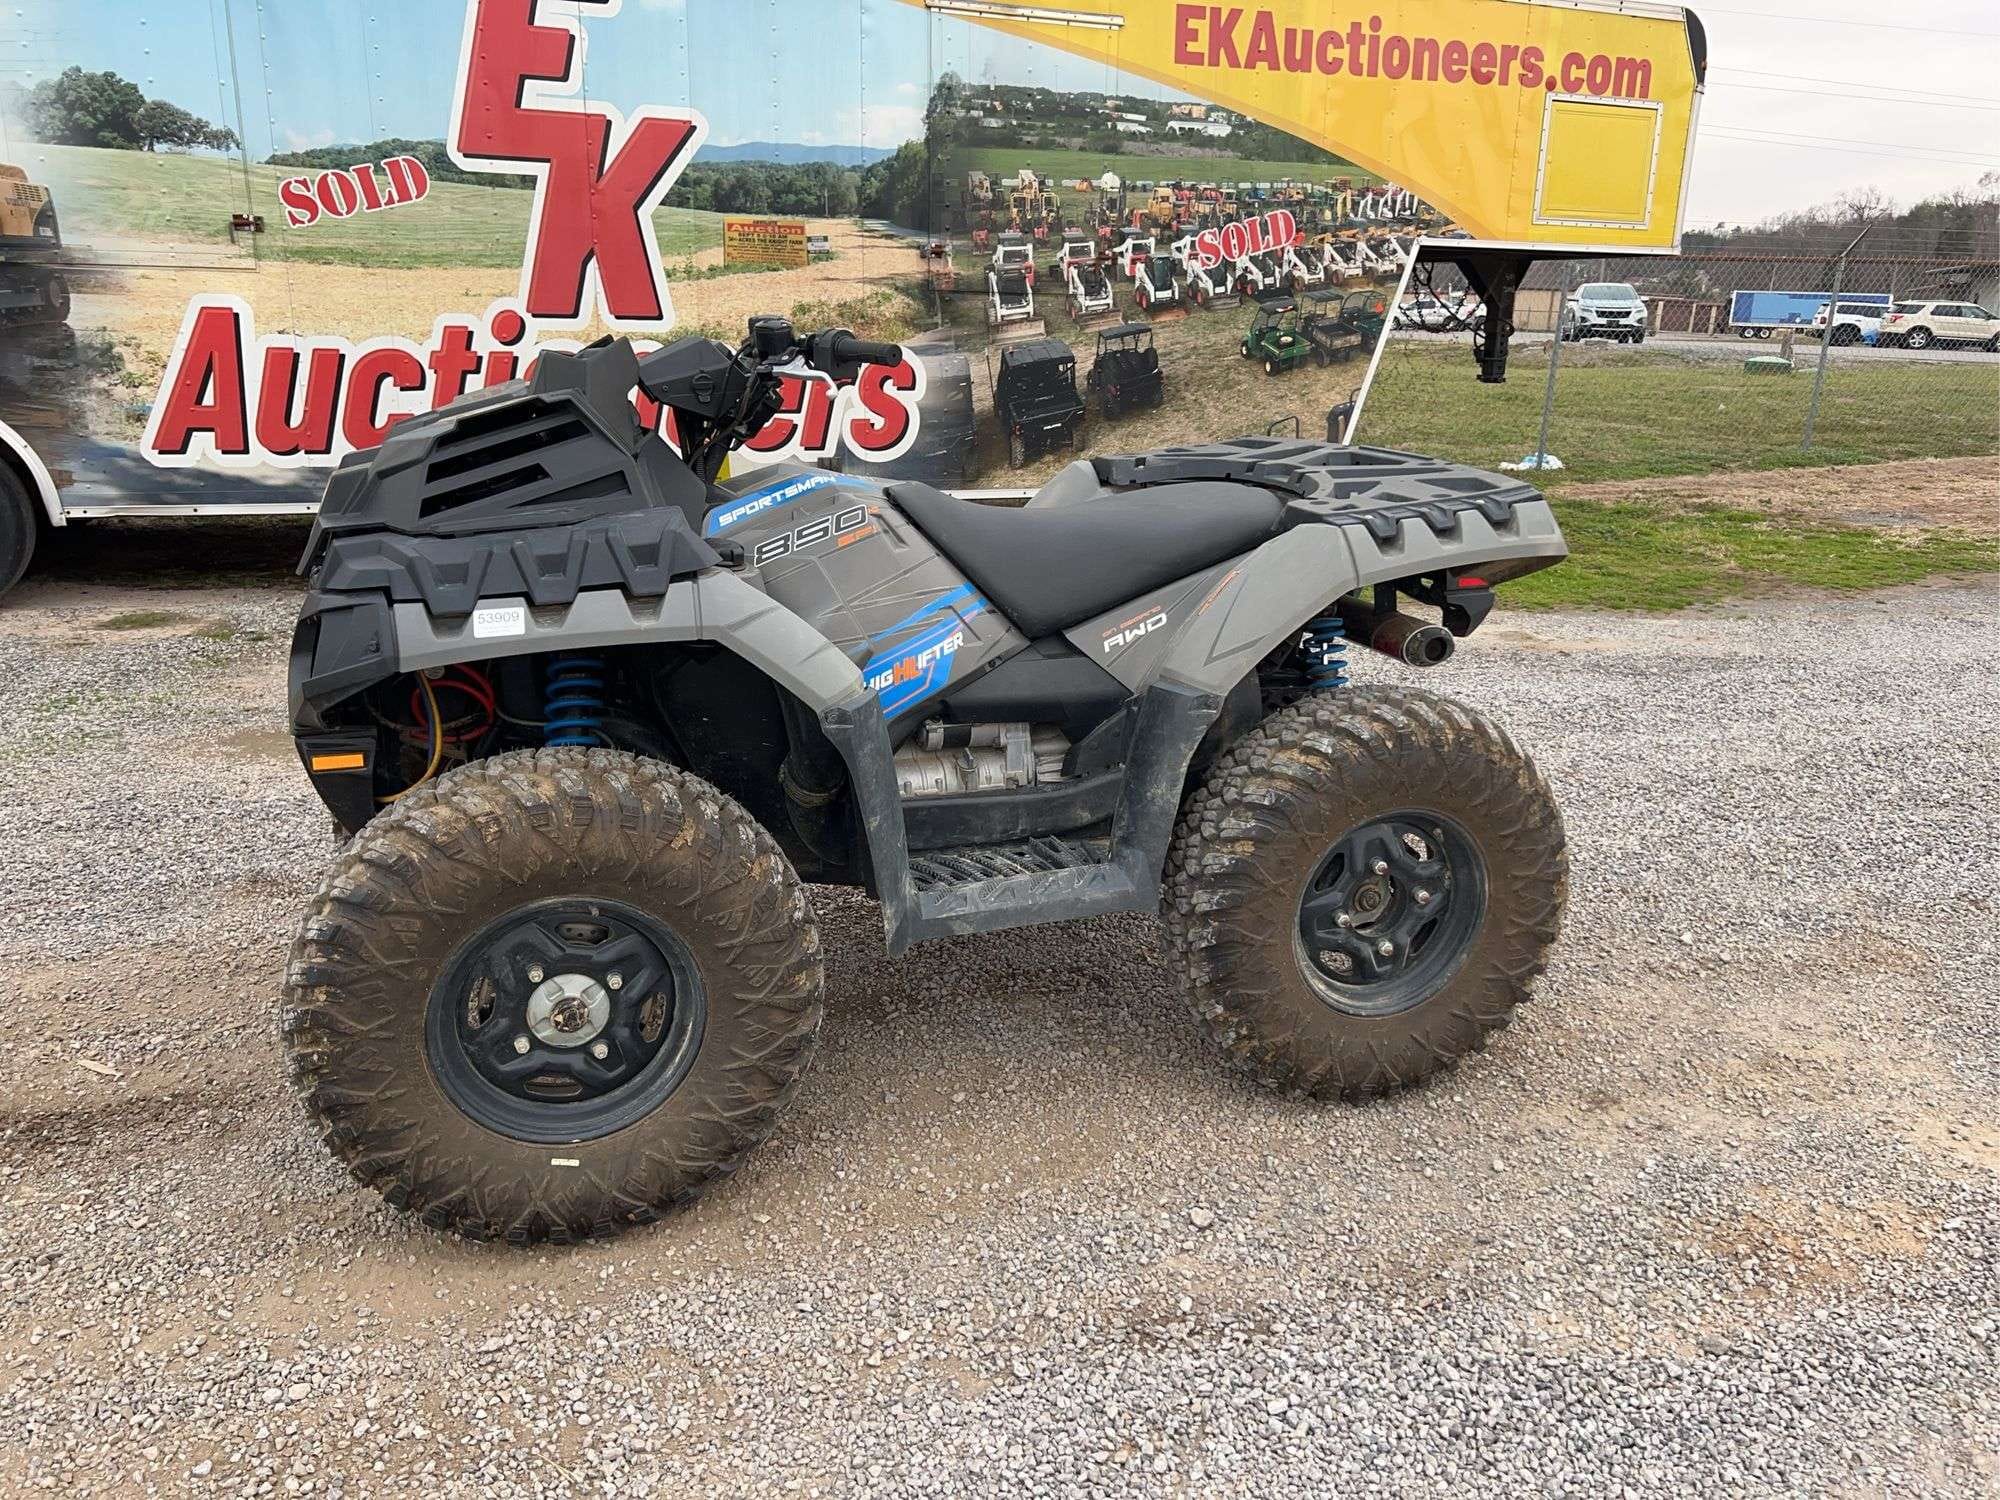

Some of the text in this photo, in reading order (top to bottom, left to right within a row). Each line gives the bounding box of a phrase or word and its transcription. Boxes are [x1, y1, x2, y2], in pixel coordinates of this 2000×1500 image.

[1174, 4, 1652, 99] EKAuctioneers.com
[457, 0, 697, 320] EK
[278, 155, 431, 228] SOLD
[730, 224, 803, 235] Auction
[1196, 209, 1296, 270] SOLD
[152, 306, 917, 454] Auctiers
[719, 476, 836, 526] SPORTSMAN
[754, 504, 867, 567] 850
[478, 610, 520, 624] 53909
[1103, 613, 1167, 653] AWD
